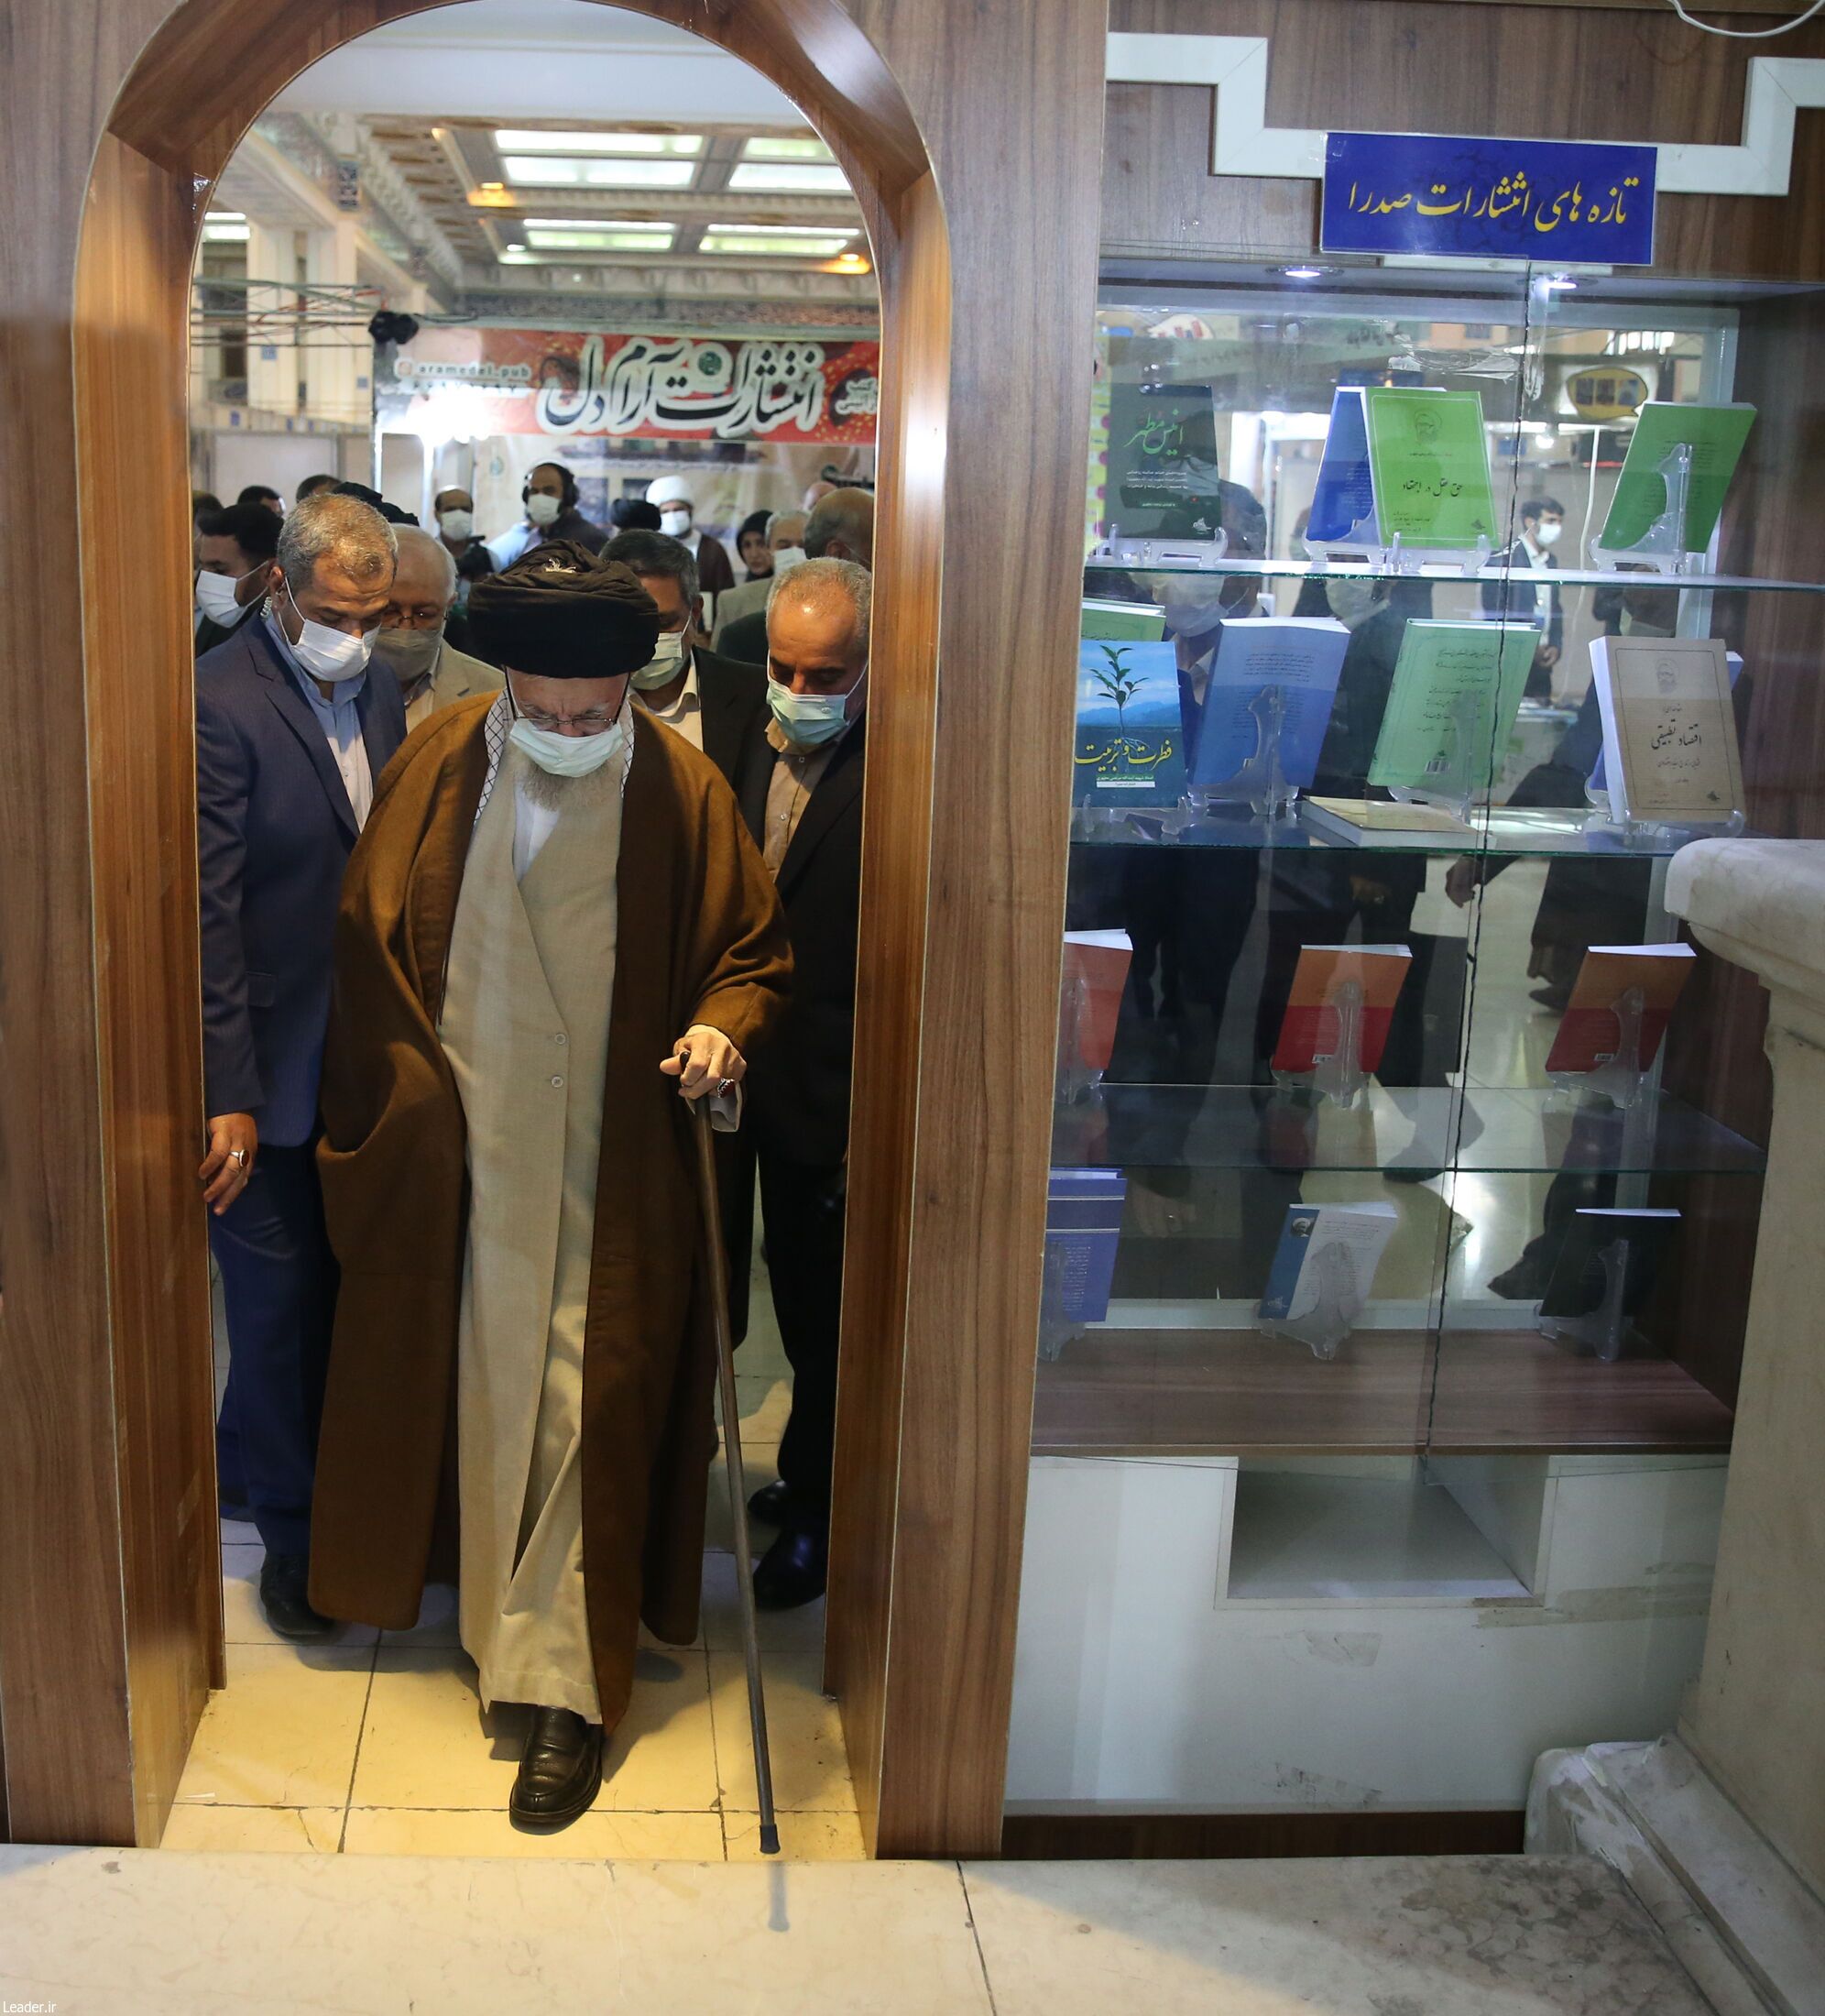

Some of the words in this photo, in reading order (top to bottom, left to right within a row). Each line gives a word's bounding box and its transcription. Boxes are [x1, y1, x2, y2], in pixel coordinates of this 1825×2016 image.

[1349, 181, 1412, 214] صدرا
[1415, 171, 1531, 218] انتشارات
[1534, 181, 1582, 232] های
[1588, 177, 1639, 225] تازه
[656, 348, 815, 429] انتشارات
[1075, 739, 1122, 772] تربیت
[1128, 740, 1172, 771] فطرت
